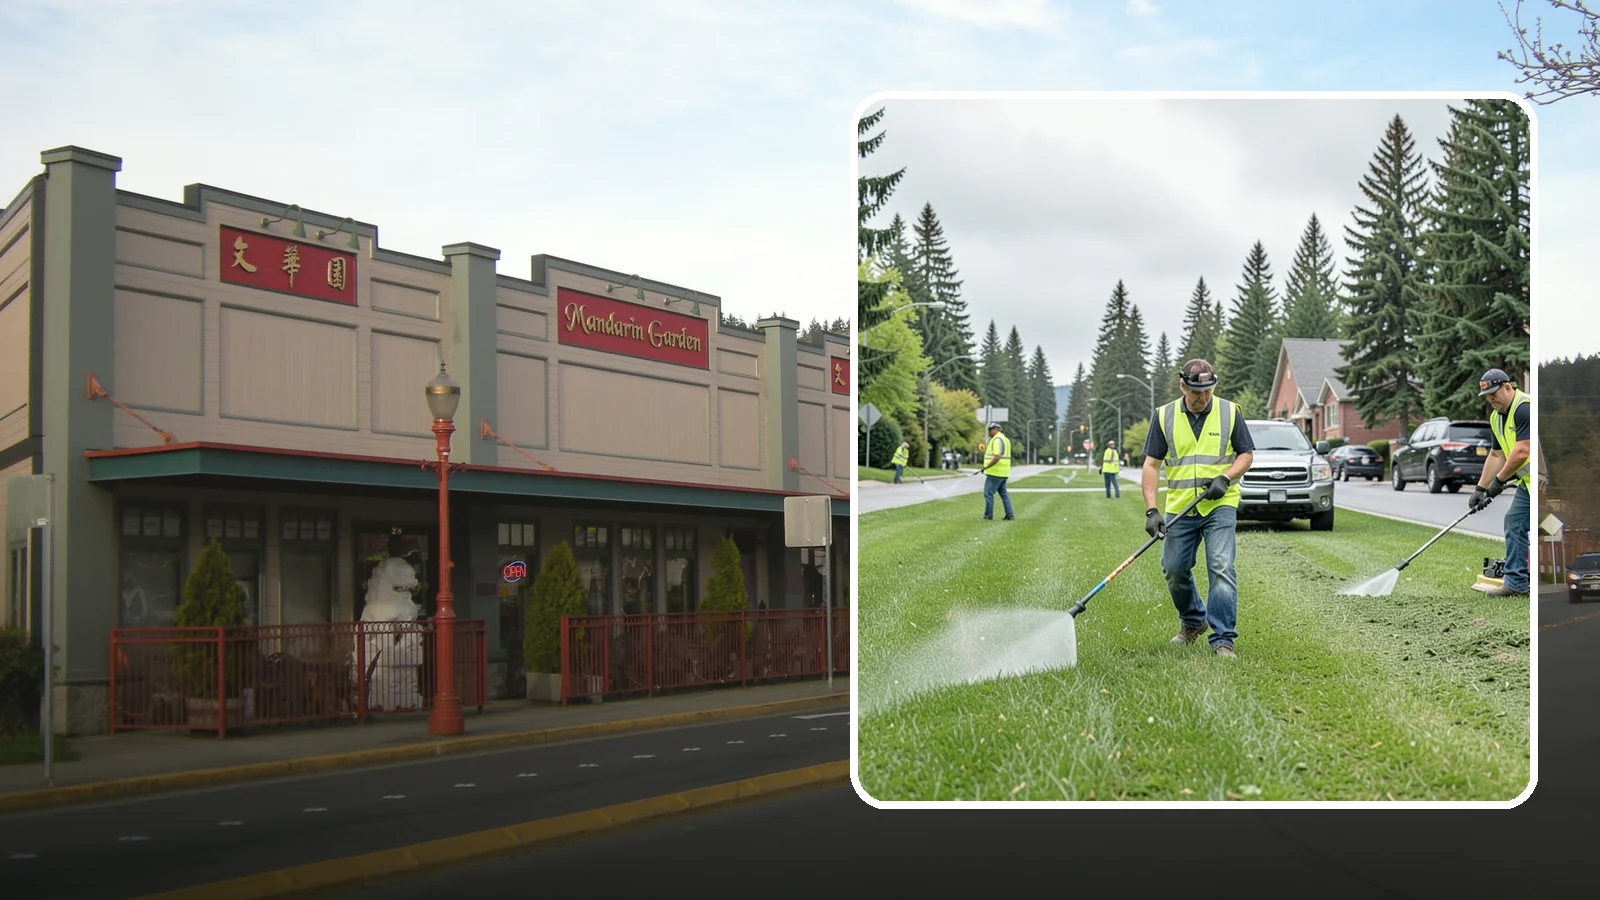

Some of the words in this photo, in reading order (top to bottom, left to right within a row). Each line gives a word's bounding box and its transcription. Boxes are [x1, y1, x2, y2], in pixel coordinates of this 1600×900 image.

[231, 236, 346, 291] 文華園
[565, 302, 644, 341] Mandarin
[648, 320, 701, 352] Garden
[503, 565, 526, 578] OPEN
